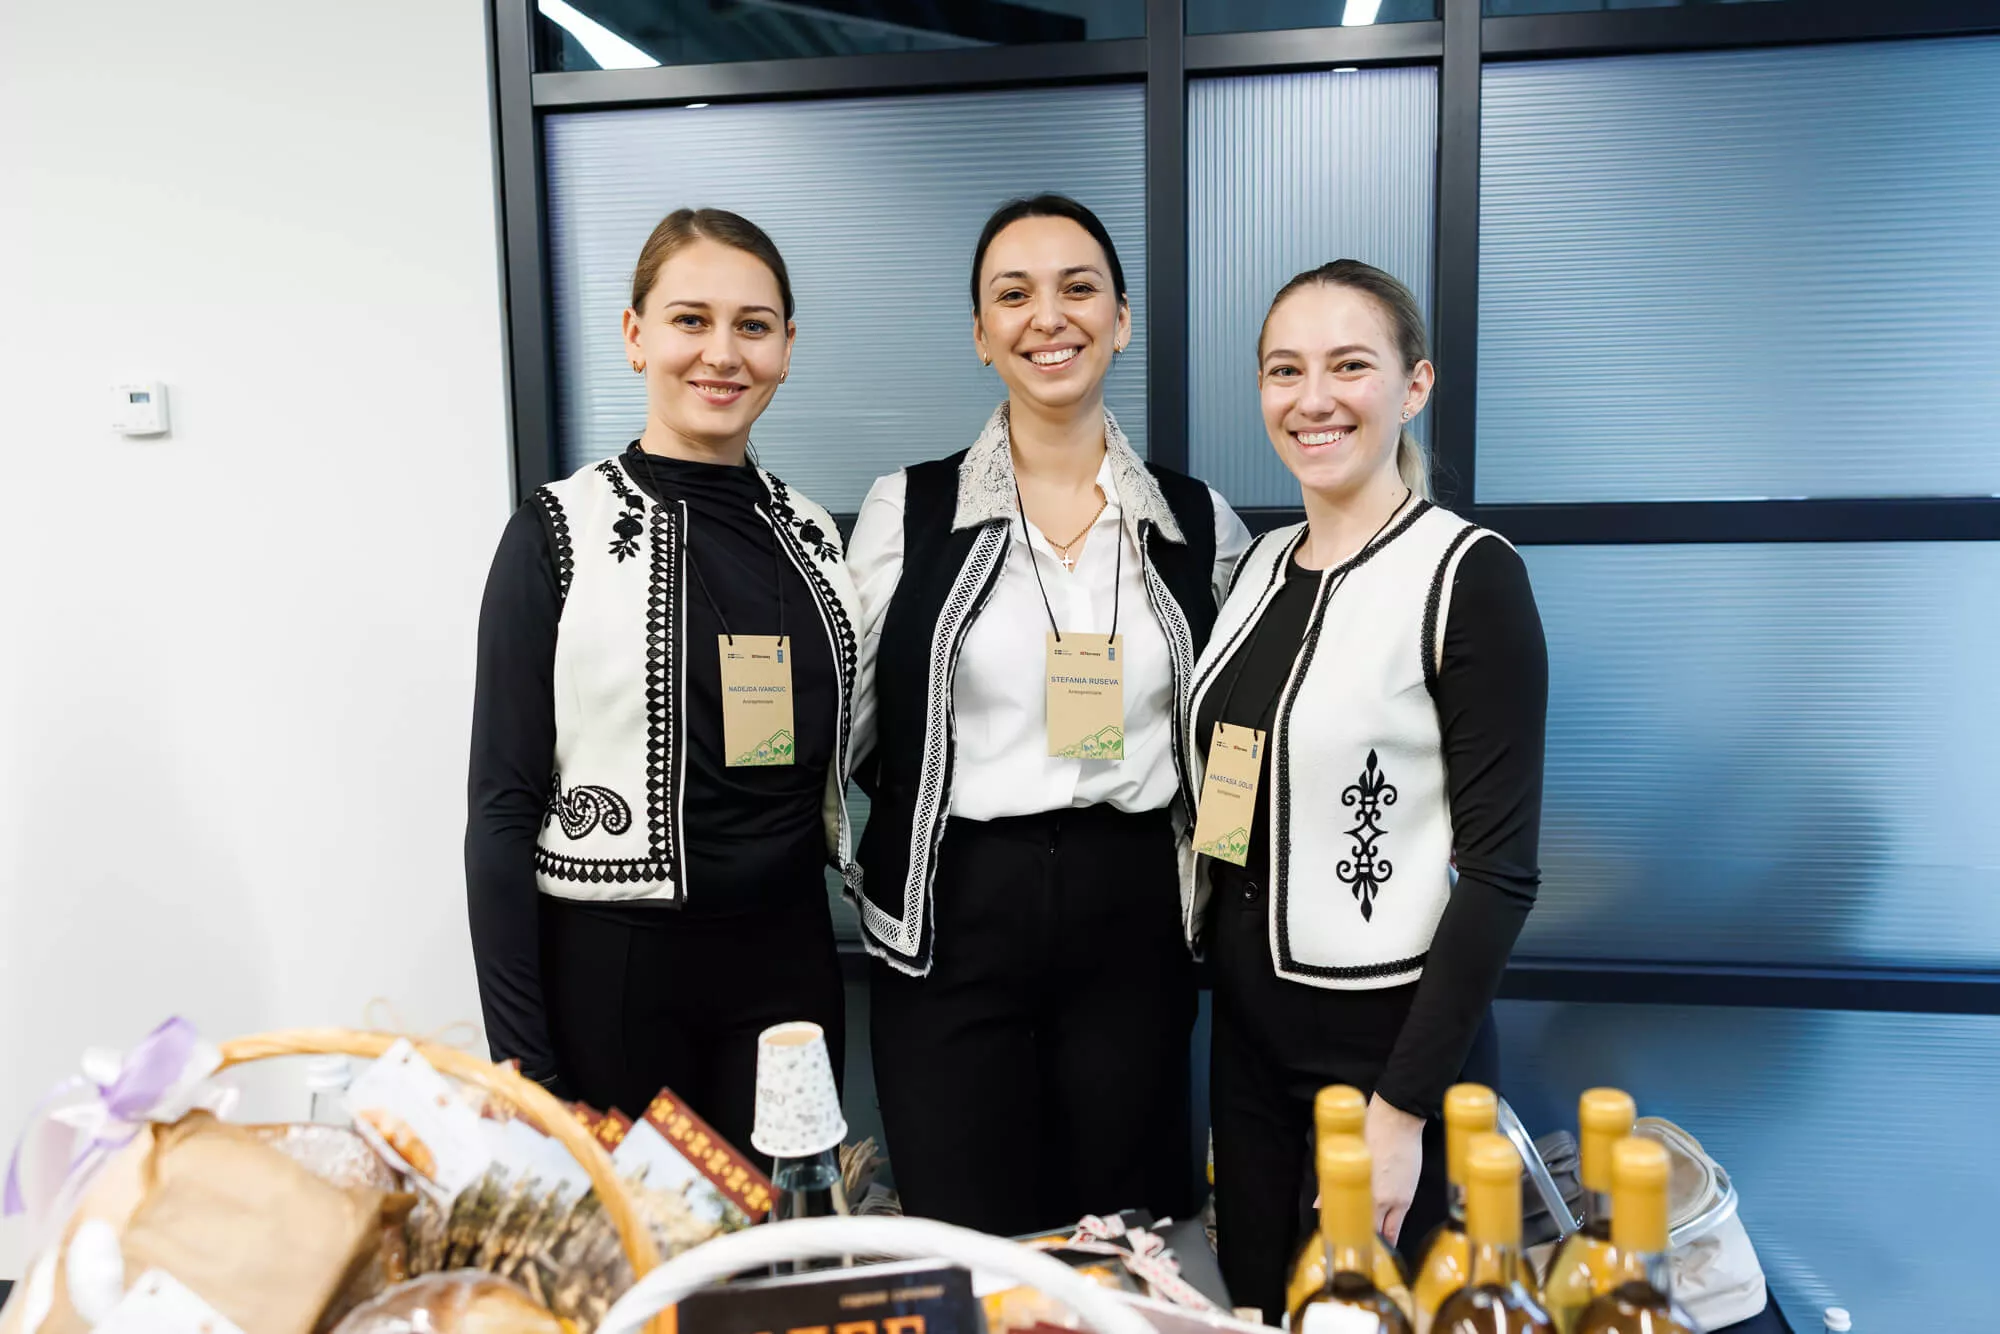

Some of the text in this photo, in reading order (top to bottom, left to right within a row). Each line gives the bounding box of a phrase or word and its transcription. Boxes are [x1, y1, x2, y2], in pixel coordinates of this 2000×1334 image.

[1051, 676, 1119, 685] STEFANIA RUSEVA
[1209, 773, 1237, 785] ANASTASIA
